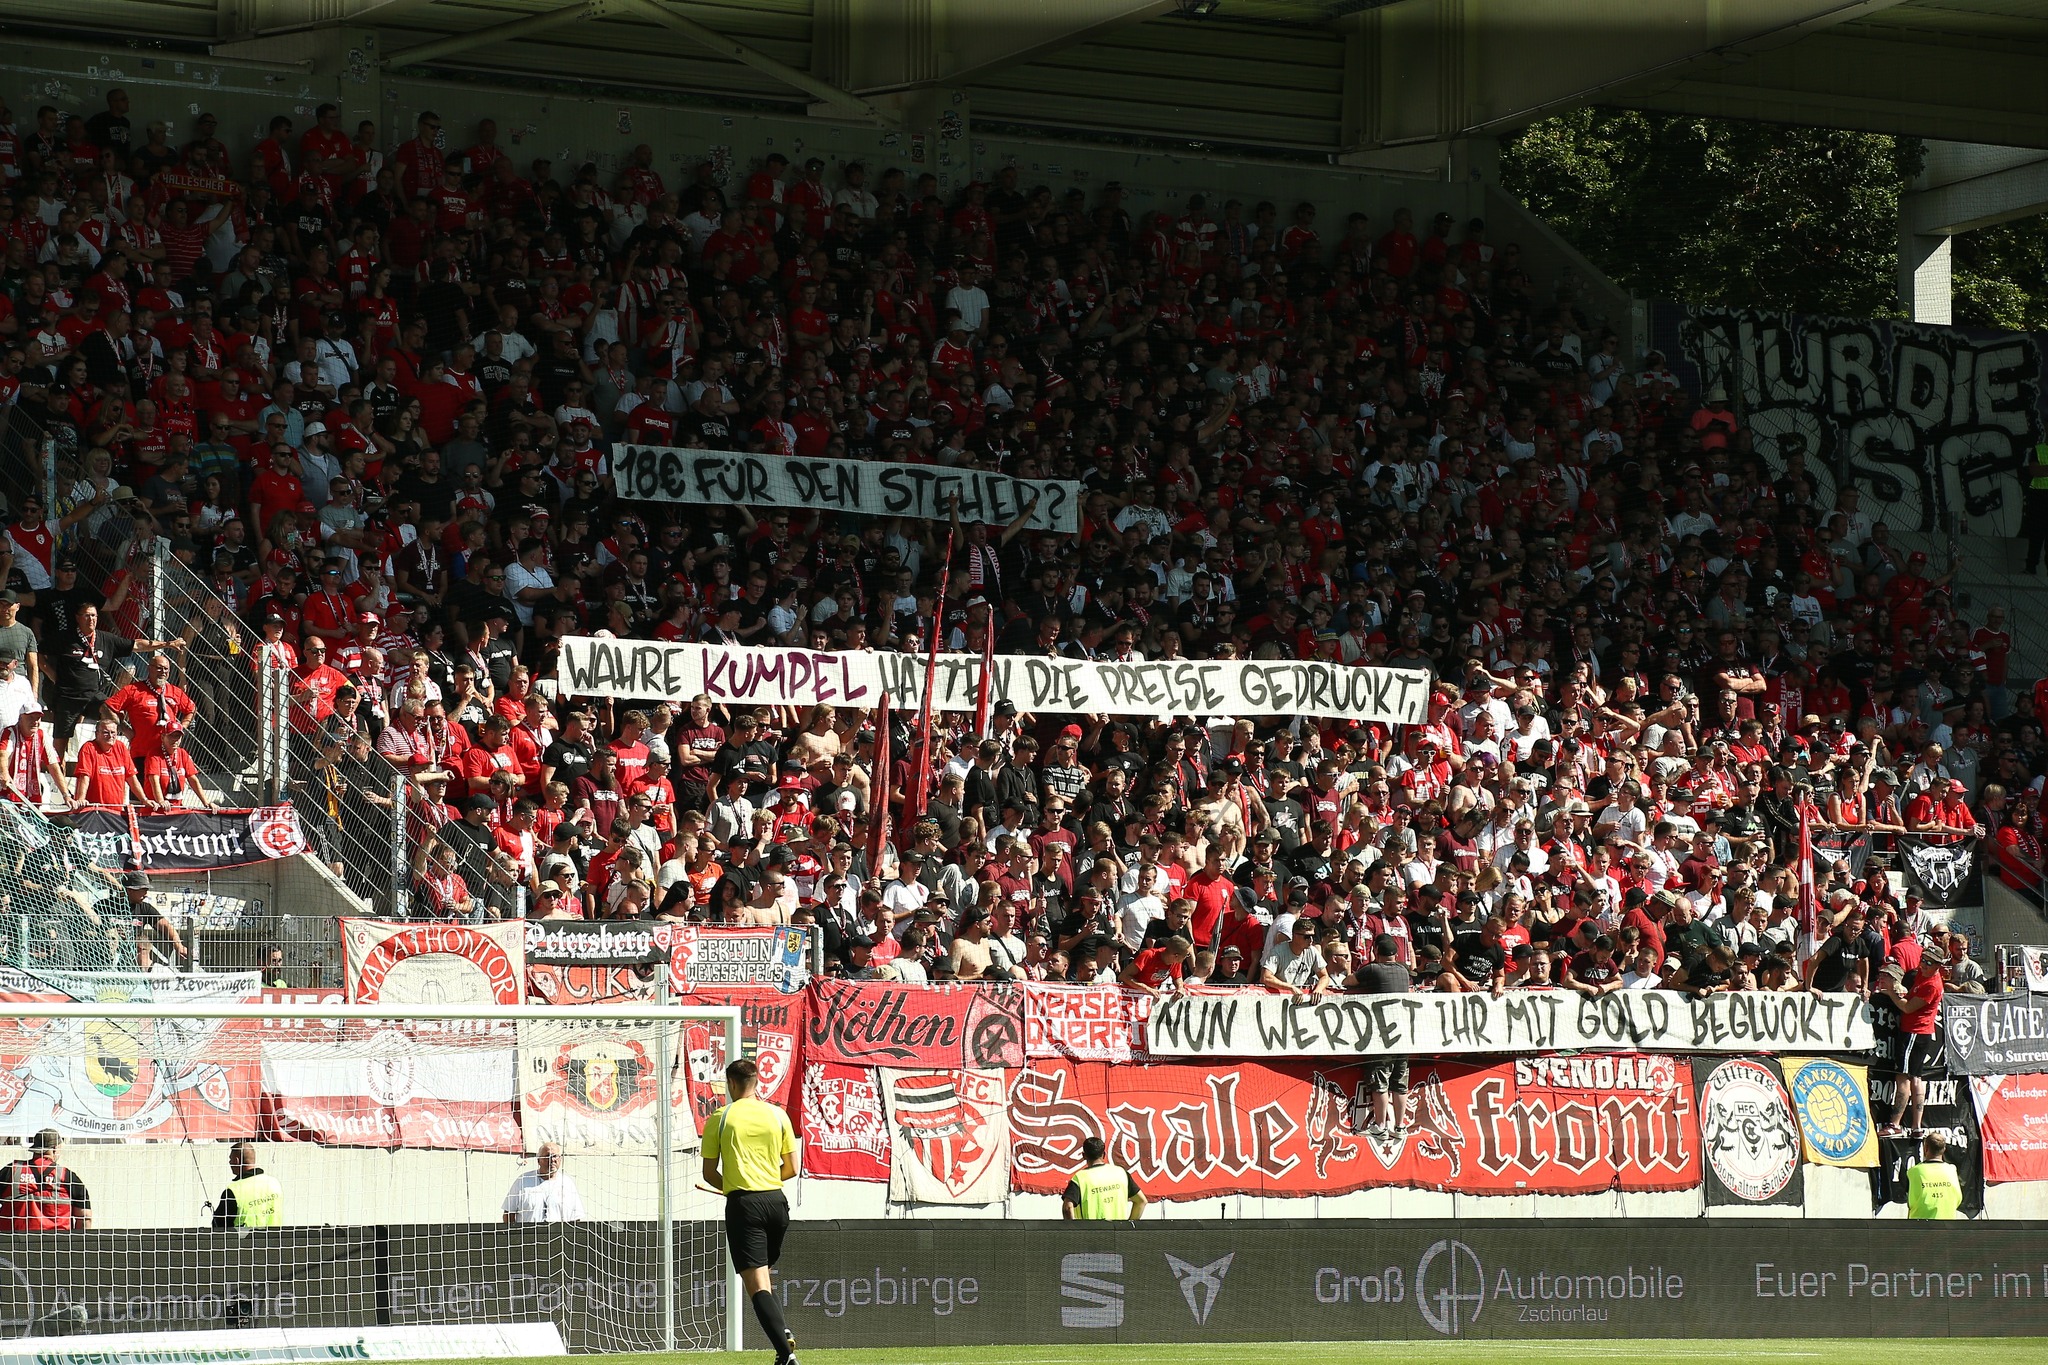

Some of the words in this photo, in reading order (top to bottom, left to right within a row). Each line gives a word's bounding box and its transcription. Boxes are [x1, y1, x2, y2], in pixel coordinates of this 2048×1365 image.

[1702, 322, 1886, 417] NUR
[1895, 338, 2030, 437] DIE
[615, 446, 686, 499] 18€
[694, 457, 776, 503] FÜR
[785, 461, 861, 508] DEN
[1749, 405, 2025, 540] BSG
[565, 641, 684, 696] WAHRE
[702, 648, 868, 702] KUMPEL
[1025, 658, 1089, 710] DIE
[1097, 663, 1225, 711] PREISE
[1240, 663, 1424, 724] GEDRÜCKT,
[259, 808, 293, 821] HFC
[525, 920, 652, 959] Petersberg
[698, 938, 773, 963] SEKTION
[357, 926, 516, 1005] MARATHONTOR
[686, 963, 784, 983] WEISSENFELS
[809, 978, 959, 1060] Köthen
[1155, 999, 1238, 1052] NUN
[1257, 995, 1423, 1051] WERDET
[1440, 998, 1492, 1047] IHR
[1505, 997, 1567, 1048] MIT
[1577, 991, 1669, 1044] GOLD
[1690, 991, 1862, 1048] BEGLÜCKT!
[1951, 1007, 1971, 1017] HFC
[759, 1033, 784, 1048] HFC
[1984, 1050, 2003, 1063] No
[1514, 1055, 1655, 1090] STENDAL
[1711, 1064, 1777, 1093] Ultras
[819, 1080, 839, 1093] HFC
[851, 1083, 867, 1098] FC
[1797, 1068, 1860, 1107] FANSZENE
[2001, 1087, 2047, 1101] Hallescher
[1737, 1104, 1755, 1114] HFC
[72, 1116, 118, 1132] Röblingen
[120, 1119, 134, 1131] am
[136, 1116, 154, 1130] See
[1008, 1067, 1301, 1187] Saale
[1466, 1076, 1692, 1179] front
[1798, 1101, 1862, 1153] LOKOMOTIVE
[20, 1172, 55, 1184] SECTY
[1091, 1183, 1121, 1195] STEWARD
[1738, 1180, 1760, 1197] alten
[1921, 1181, 1952, 1189] STEWARD
[1103, 1196, 1115, 1204] 437
[1315, 1265, 1405, 1304] Groß
[1493, 1265, 1684, 1300] Automobile
[1756, 1262, 1837, 1299] Euer
[1848, 1262, 1982, 1299] Partner
[1993, 1262, 2032, 1298] im
[390, 1273, 494, 1316] Euer
[1518, 1304, 1609, 1322] Zschorlau
